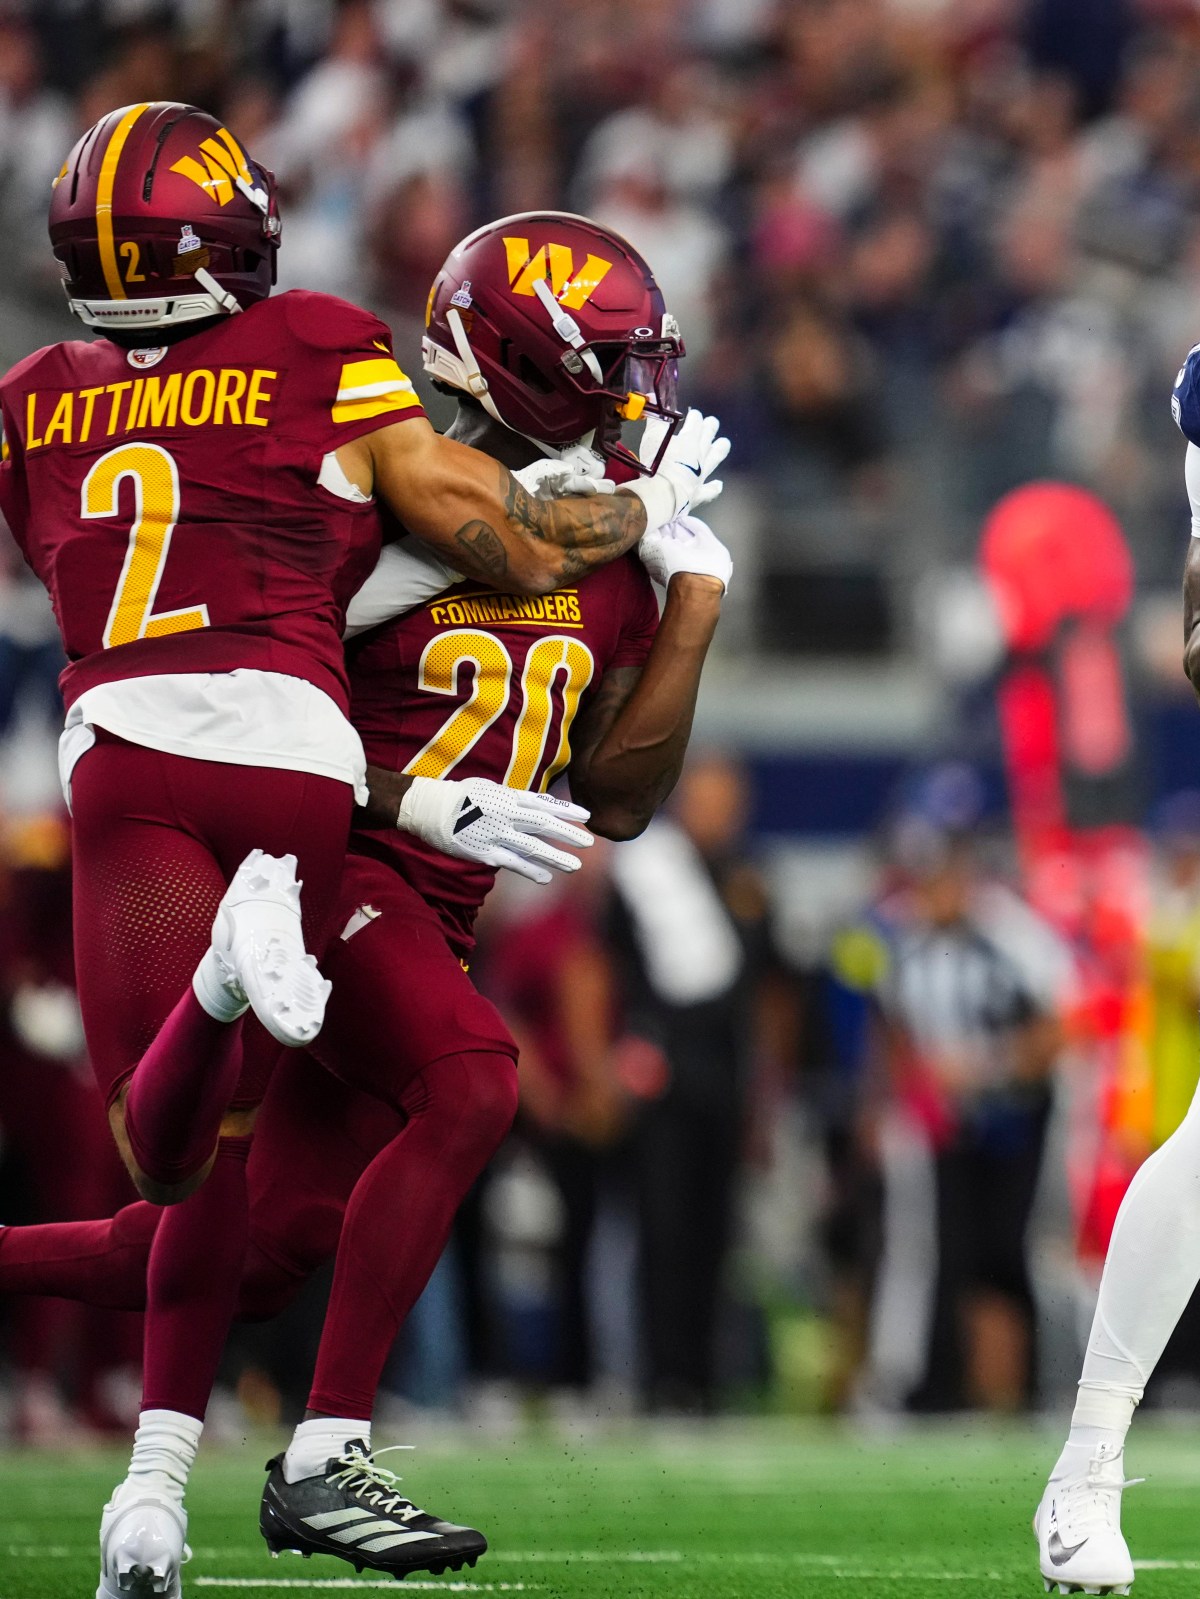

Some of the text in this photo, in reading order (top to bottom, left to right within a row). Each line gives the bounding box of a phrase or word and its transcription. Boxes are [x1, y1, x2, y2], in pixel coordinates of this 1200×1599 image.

[120, 242, 146, 283] 2
[94, 308, 159, 316] WASHINGTON
[26, 369, 277, 450] LATTIMORE
[80, 442, 211, 650] 2
[431, 594, 581, 625] COMMANDERS
[401, 628, 595, 794] 20
[536, 794, 570, 808] ADIZERO
